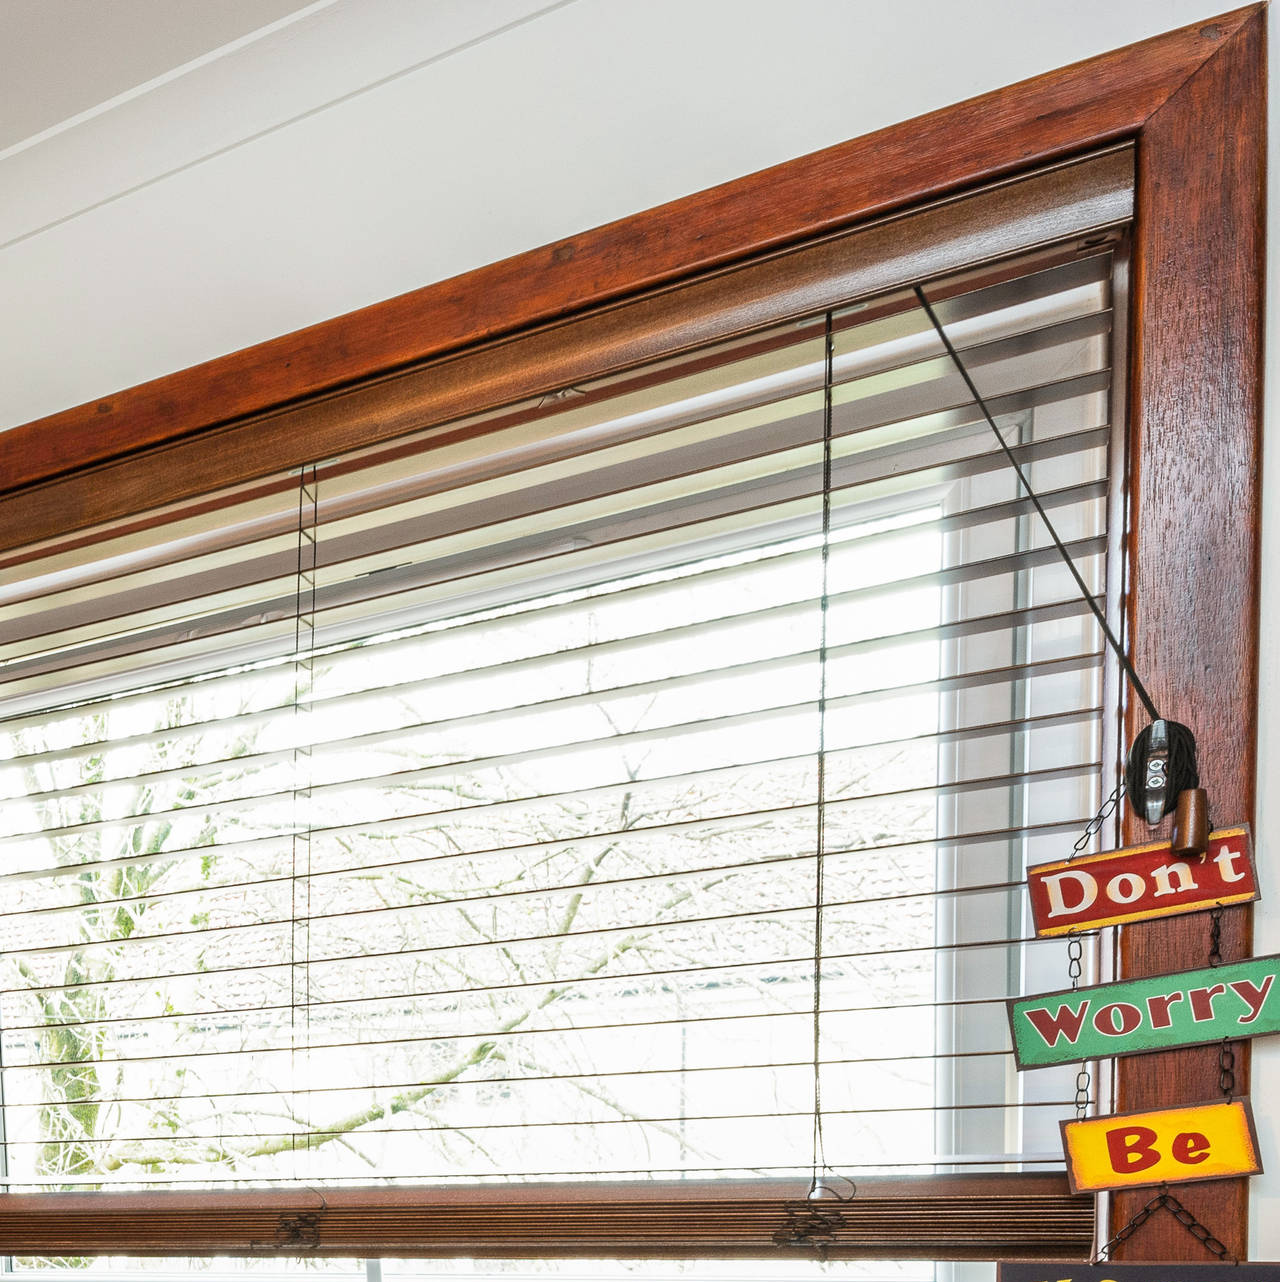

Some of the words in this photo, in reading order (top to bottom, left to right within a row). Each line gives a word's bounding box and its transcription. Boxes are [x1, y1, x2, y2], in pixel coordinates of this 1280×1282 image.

[1041, 845, 1246, 920] Don't
[1023, 974, 1277, 1049] Worry
[1106, 1127, 1211, 1174] Be
